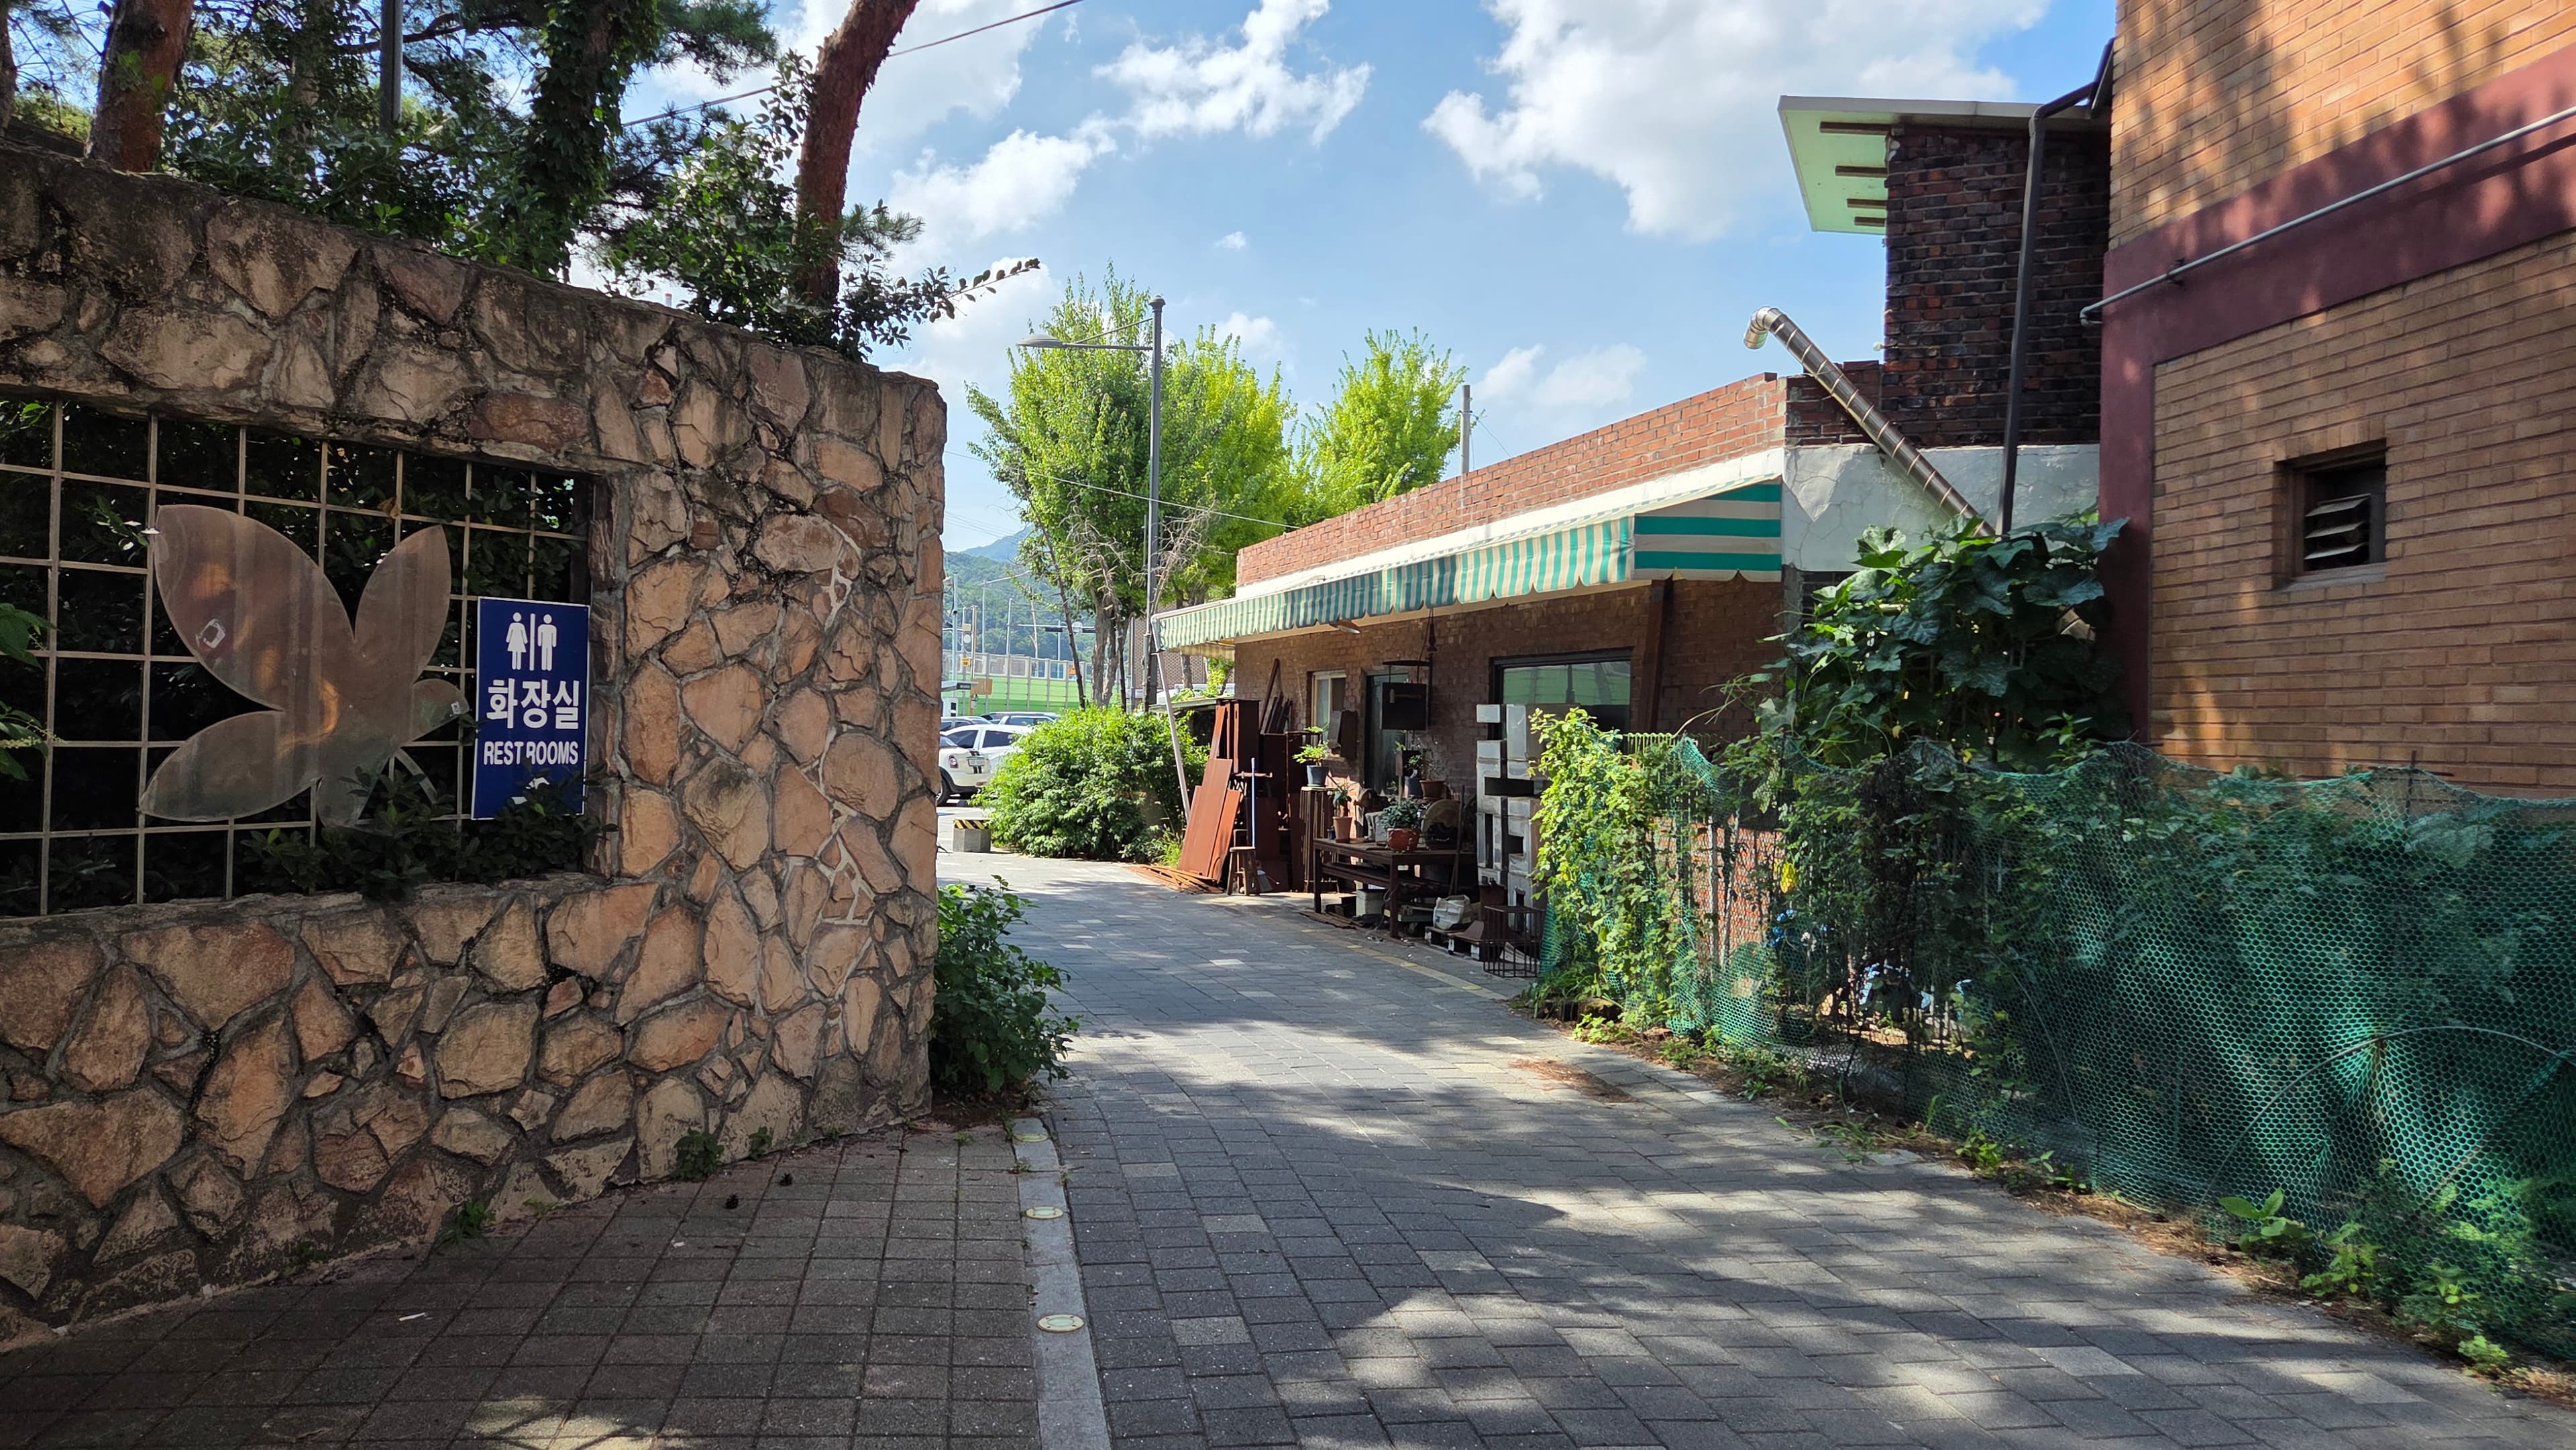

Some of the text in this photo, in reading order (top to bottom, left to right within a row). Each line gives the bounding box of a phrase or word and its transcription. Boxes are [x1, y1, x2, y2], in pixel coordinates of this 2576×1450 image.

[486, 678, 580, 730] 화장실
[484, 741, 578, 765] REST ROOMS
